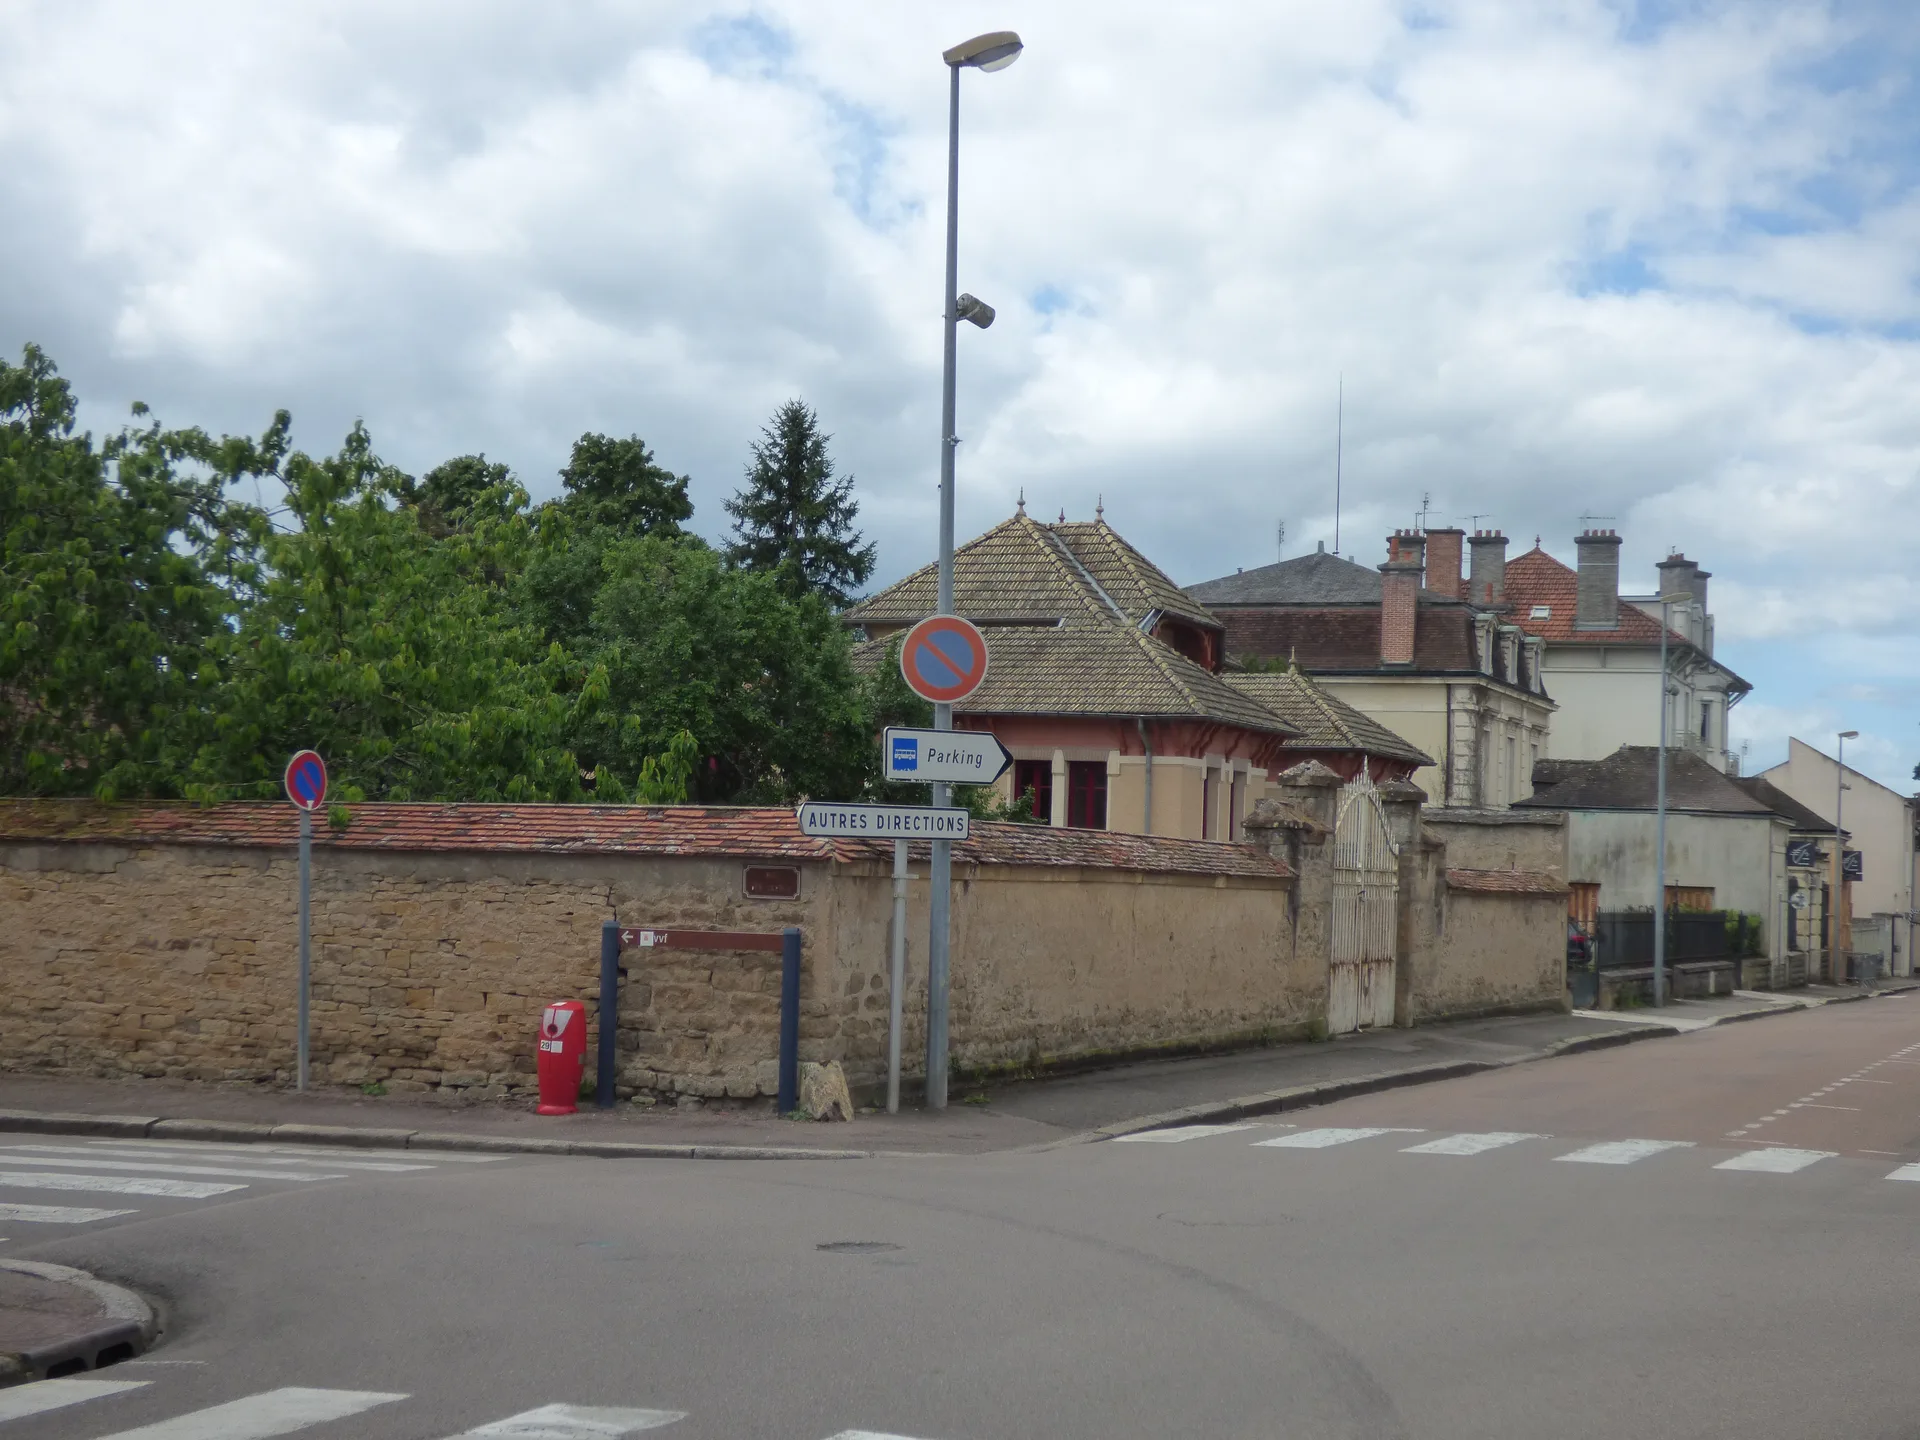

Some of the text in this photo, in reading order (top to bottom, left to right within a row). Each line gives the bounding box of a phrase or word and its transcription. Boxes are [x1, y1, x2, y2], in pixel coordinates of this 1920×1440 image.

[927, 748, 983, 769] Parking
[809, 812, 964, 832] AUTRES DIRECTIONS
